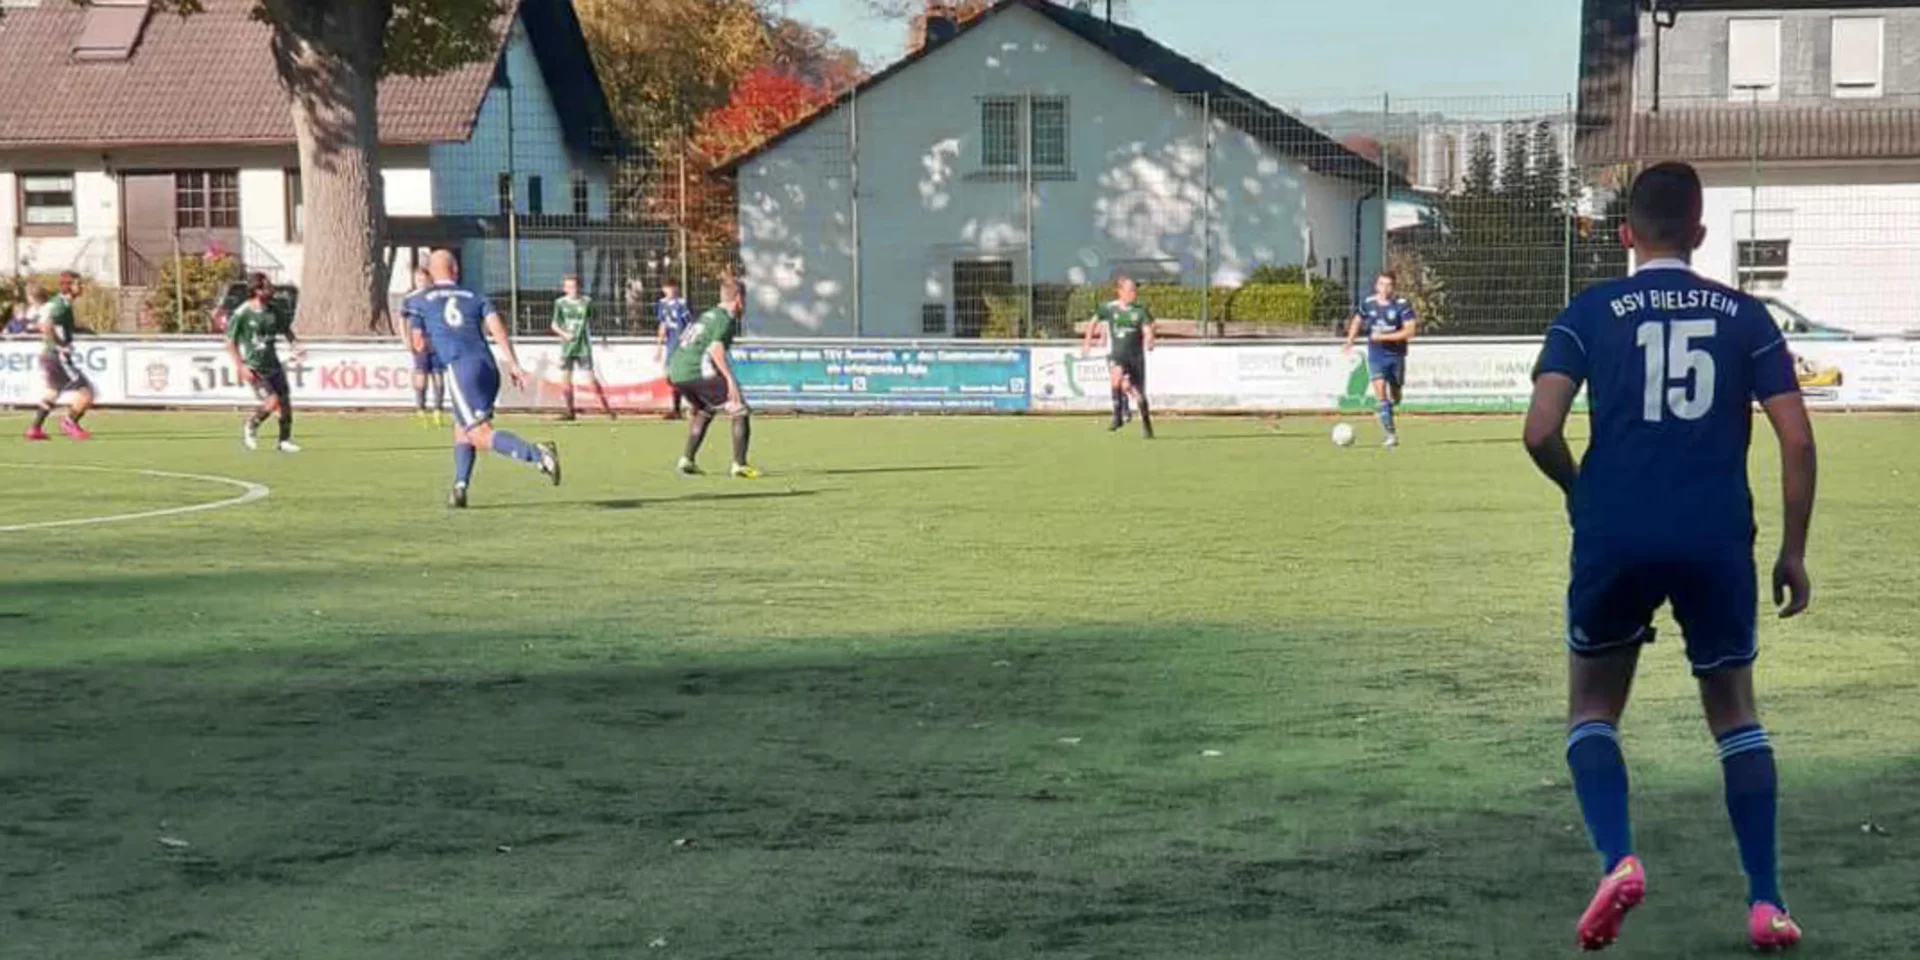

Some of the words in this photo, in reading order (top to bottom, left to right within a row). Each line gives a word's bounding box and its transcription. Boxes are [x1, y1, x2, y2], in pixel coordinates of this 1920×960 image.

[444, 296, 463, 327] 6
[1610, 291, 1645, 317] BSV
[1650, 289, 1739, 317] BIELSTEIN
[320, 360, 414, 391] KÖLSC
[1636, 319, 1717, 422] 15
